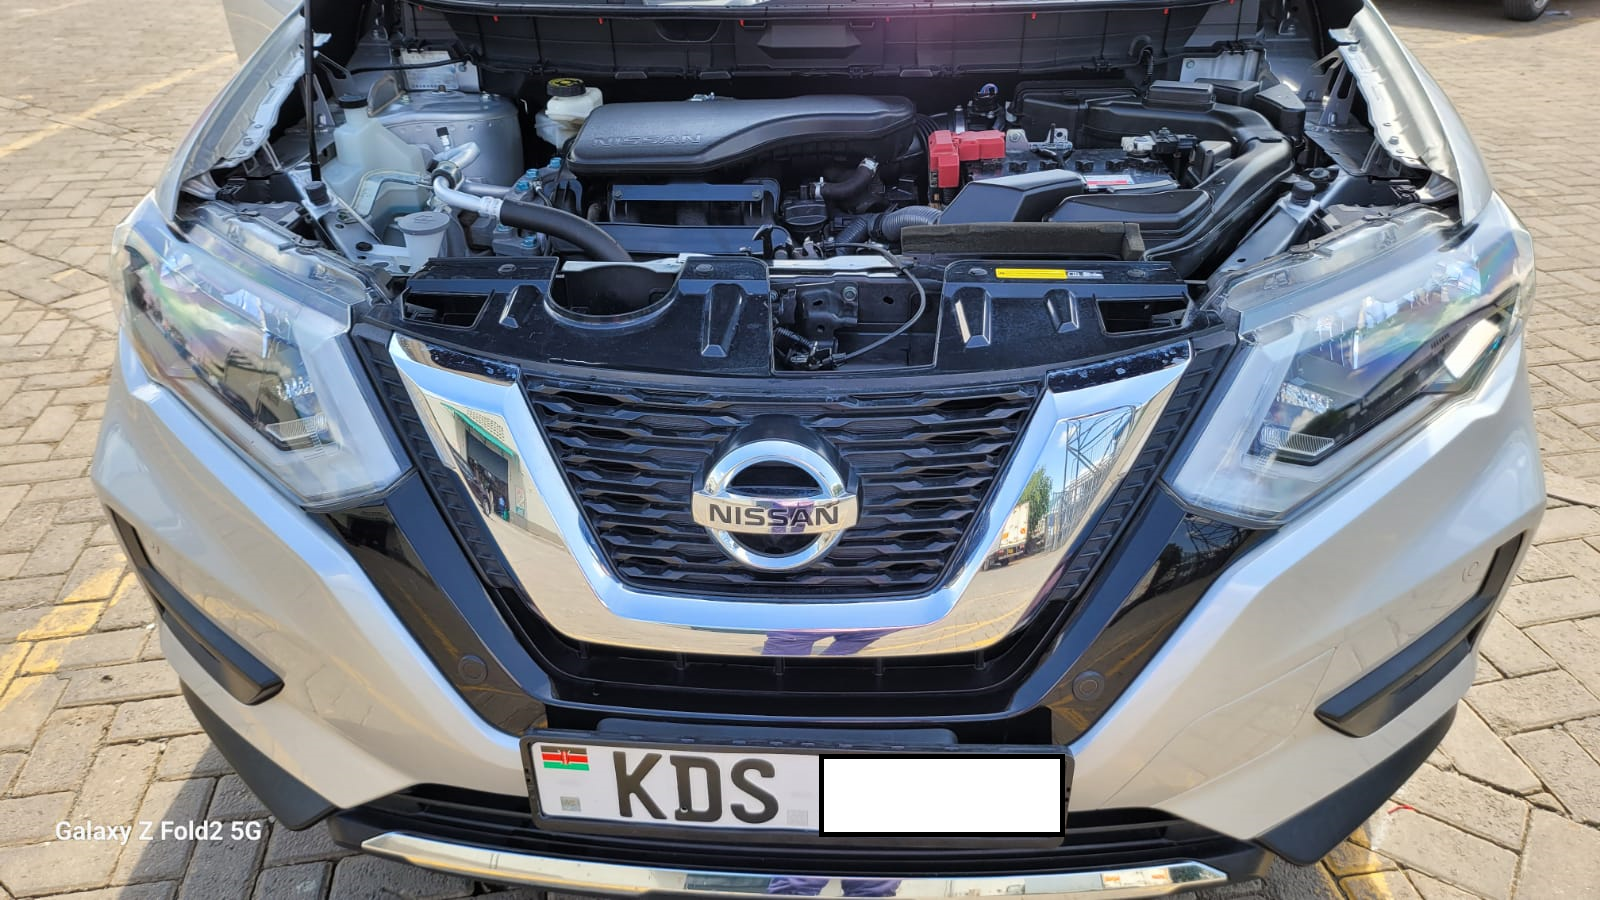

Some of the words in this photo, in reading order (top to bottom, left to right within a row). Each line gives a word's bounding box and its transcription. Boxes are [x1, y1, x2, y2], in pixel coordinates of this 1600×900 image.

[592, 133, 703, 147] NISSAN
[709, 503, 838, 527] NISSAN
[613, 751, 779, 824] KDS
